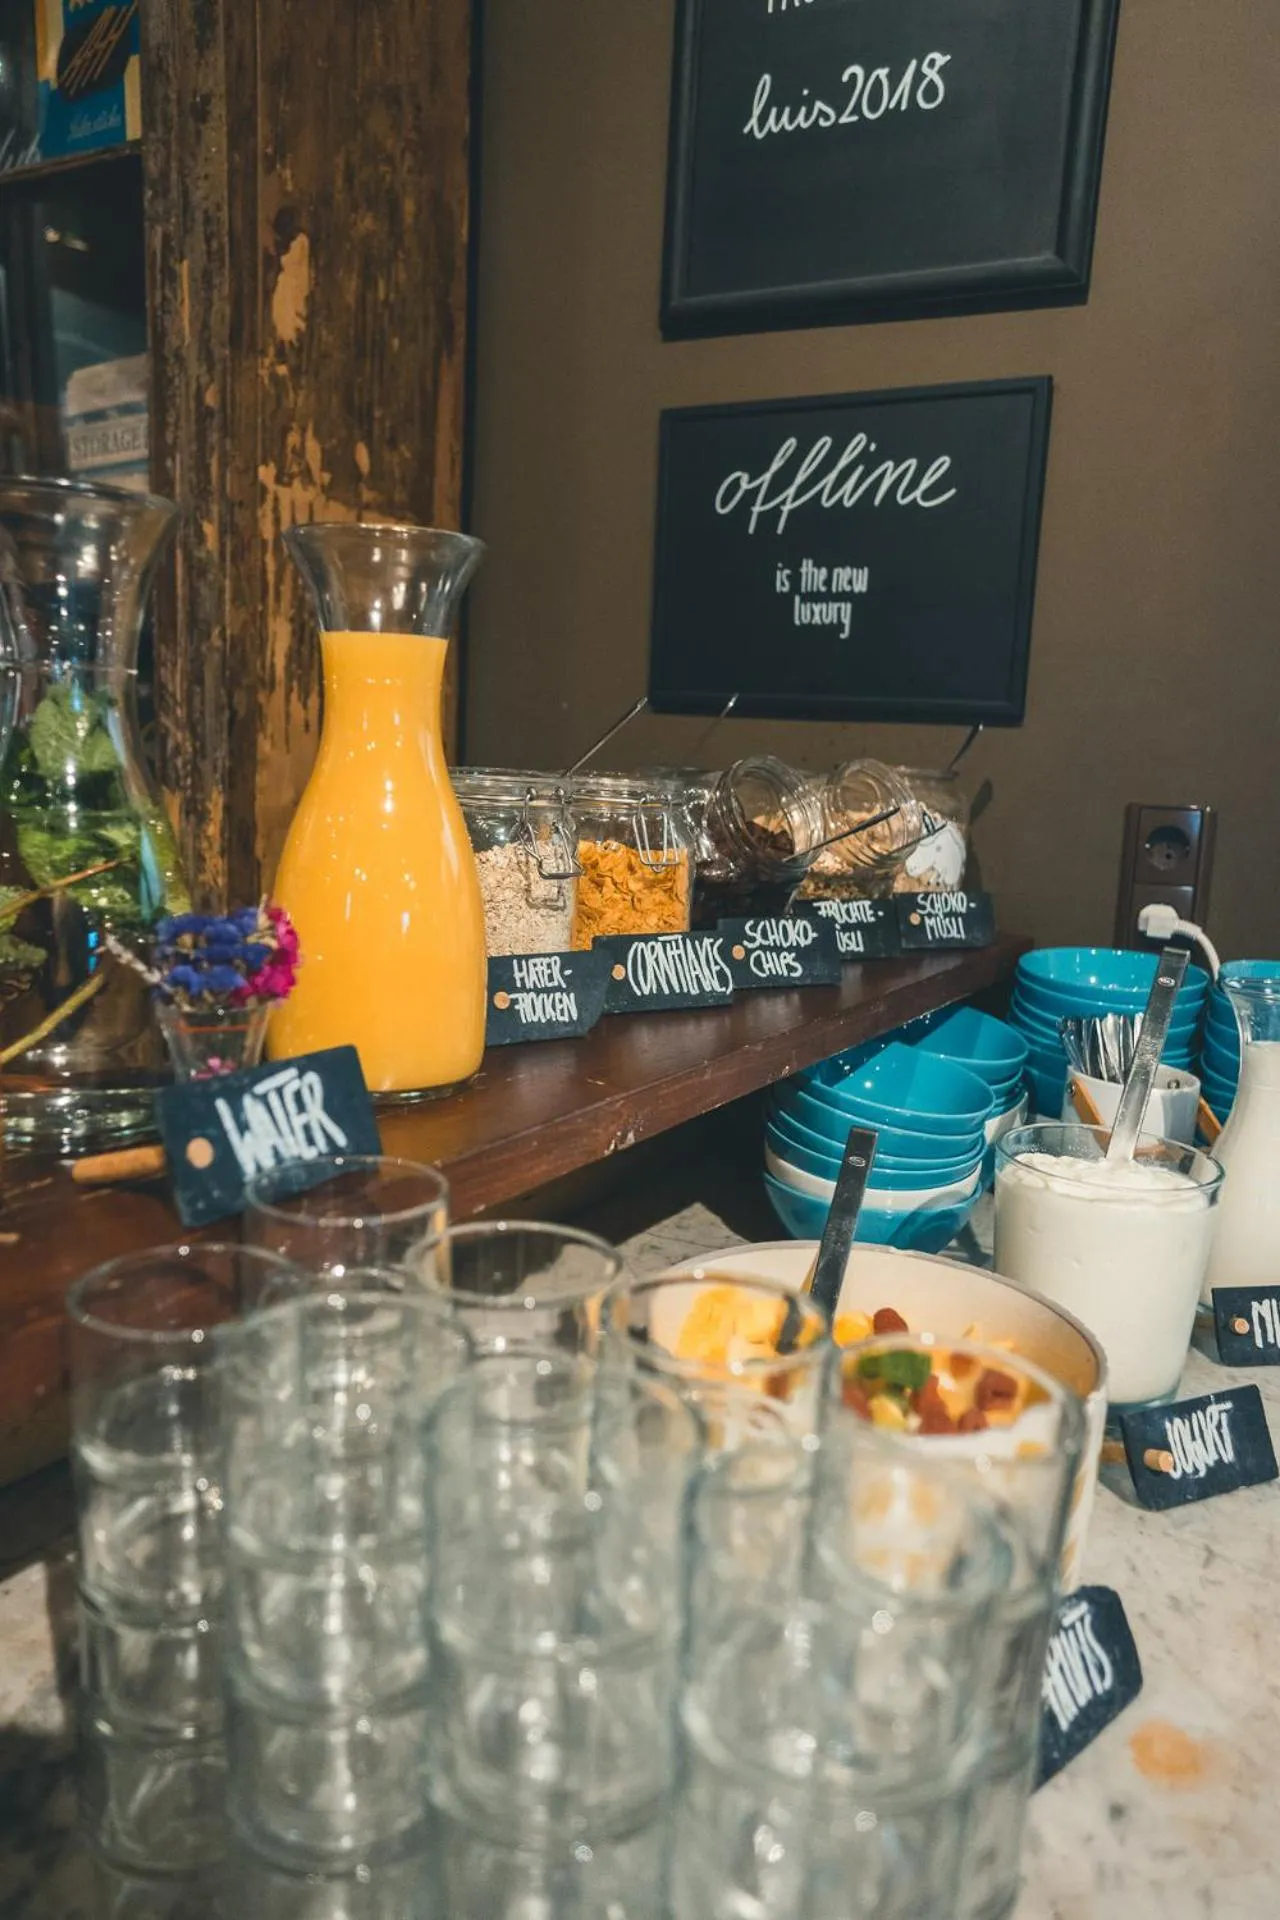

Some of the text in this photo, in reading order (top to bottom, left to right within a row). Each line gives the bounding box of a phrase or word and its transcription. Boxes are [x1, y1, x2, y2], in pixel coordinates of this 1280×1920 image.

[743, 51, 951, 140] luis2018
[715, 433, 957, 535] offline
[776, 558, 869, 593] is the new
[794, 594, 852, 639] luxury
[835, 923, 865, 953] ÜSLI
[749, 950, 804, 979] CHIPS
[214, 1066, 349, 1182] WATER
